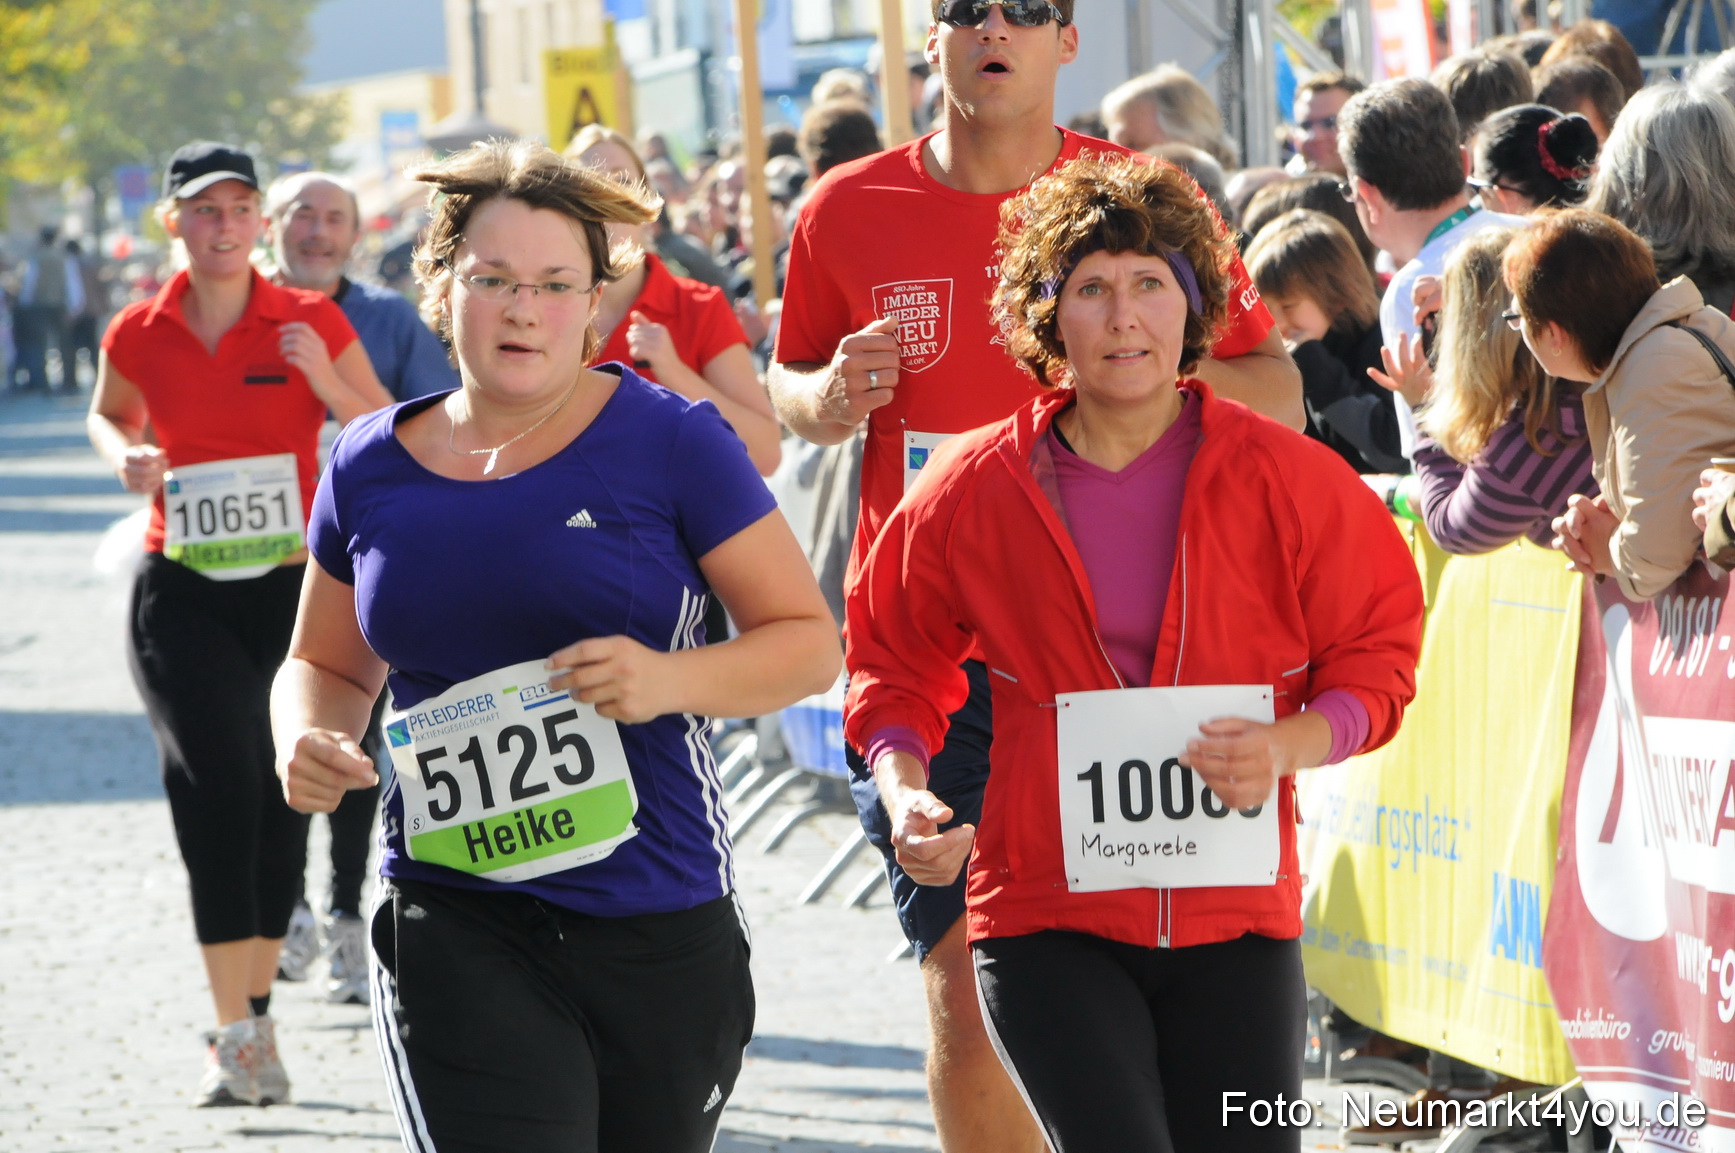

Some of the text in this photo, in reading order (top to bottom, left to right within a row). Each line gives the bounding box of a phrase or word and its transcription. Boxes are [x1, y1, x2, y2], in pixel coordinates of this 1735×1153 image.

[565, 86, 606, 143] A
[883, 291, 938, 310] IMMER
[906, 284, 925, 292] Jahre
[175, 489, 290, 537] 10651
[566, 519, 597, 529] adidas
[181, 536, 294, 565] Alexandra
[519, 681, 556, 702] BO
[409, 693, 497, 732] PFLEIDERER
[415, 712, 500, 744] AKTIENGESELLSCHAFT
[416, 708, 595, 822] 5125
[1077, 757, 1264, 824] 100
[463, 808, 575, 863] Heike
[1081, 833, 1198, 866] Margarete
